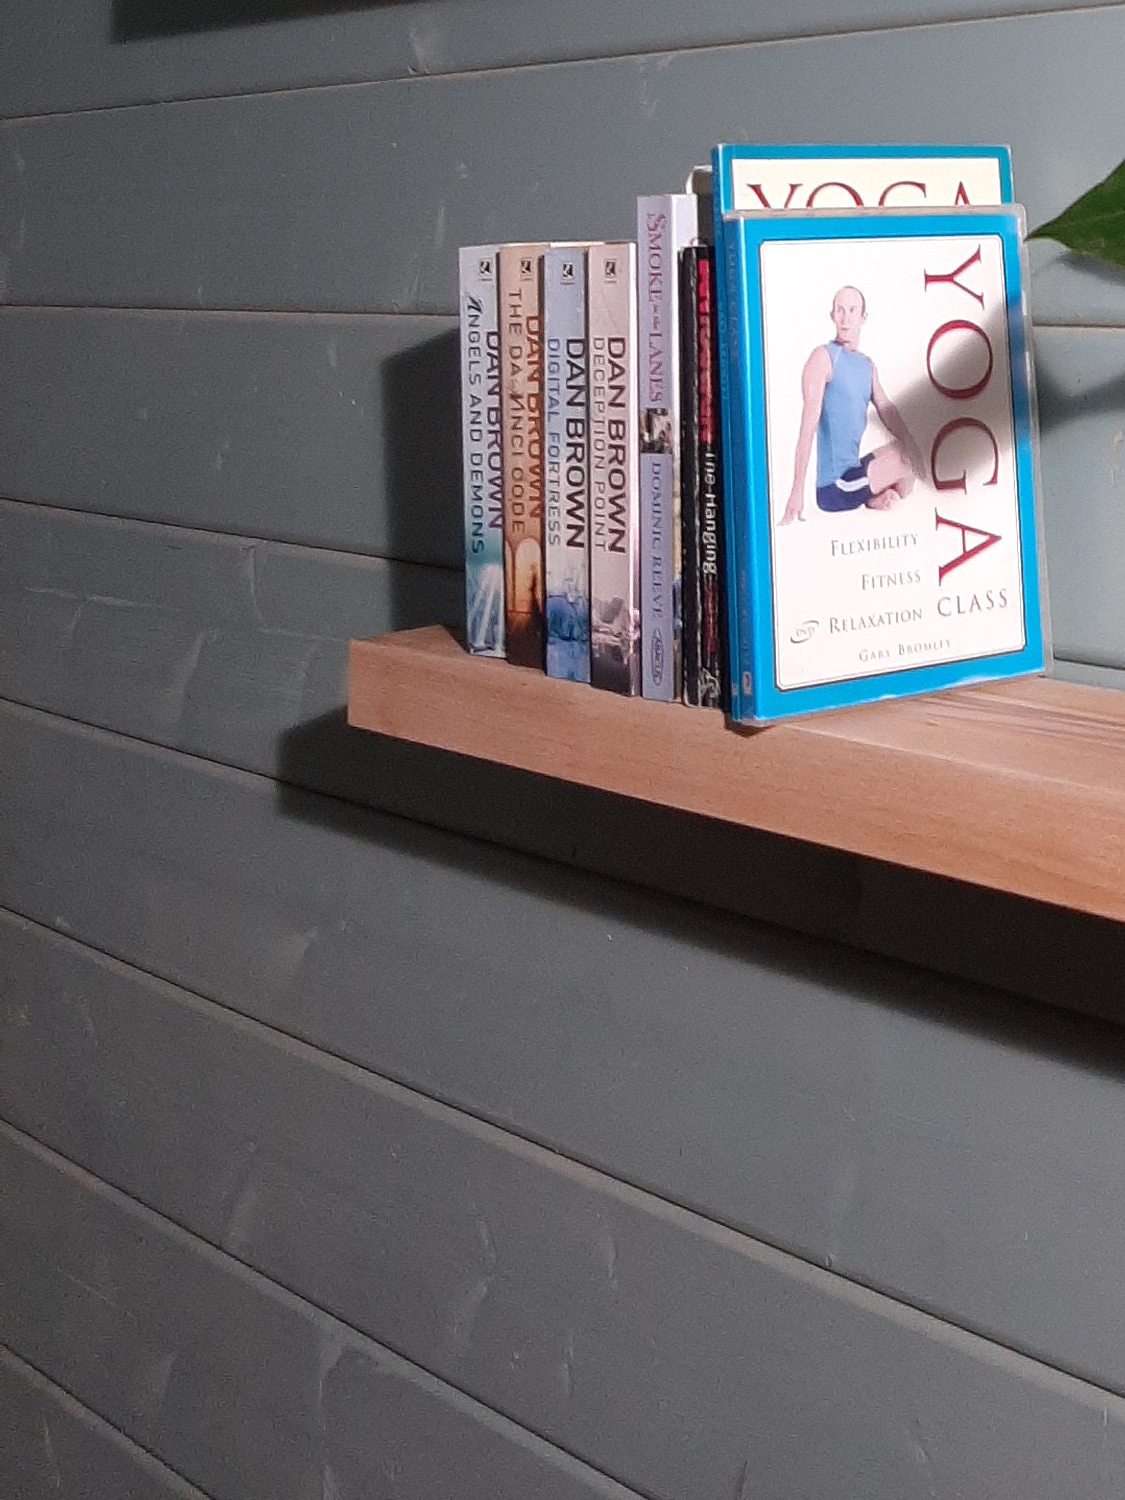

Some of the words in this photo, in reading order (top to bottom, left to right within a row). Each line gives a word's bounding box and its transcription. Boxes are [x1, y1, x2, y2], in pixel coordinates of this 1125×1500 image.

[646, 212, 666, 300] SMOKE
[467, 292, 484, 386] ANGELS
[508, 288, 523, 335] THE
[525, 315, 541, 382] DAN
[485, 331, 501, 397] DAN
[509, 345, 523, 376] DA
[547, 338, 561, 422] DIGITAL
[565, 338, 585, 408] DAN
[607, 336, 626, 409] DAN
[649, 333, 664, 403] LANES
[469, 393, 483, 442] AND
[509, 392, 525, 456] VINCI
[593, 337, 606, 470] DECEPTION
[923, 244, 1002, 587] YOGA
[486, 406, 503, 530] BROWN
[527, 393, 542, 519] BROWN
[547, 432, 561, 546] FORTRESS
[565, 417, 586, 549] BROWN
[607, 418, 626, 554] BROWN
[470, 452, 485, 555] DEMONS
[510, 466, 525, 534] CODE
[593, 480, 607, 552] POINT
[651, 461, 665, 549] DOMINIC
[701, 493, 717, 575] Hanging
[936, 588, 1008, 618] CLASS
